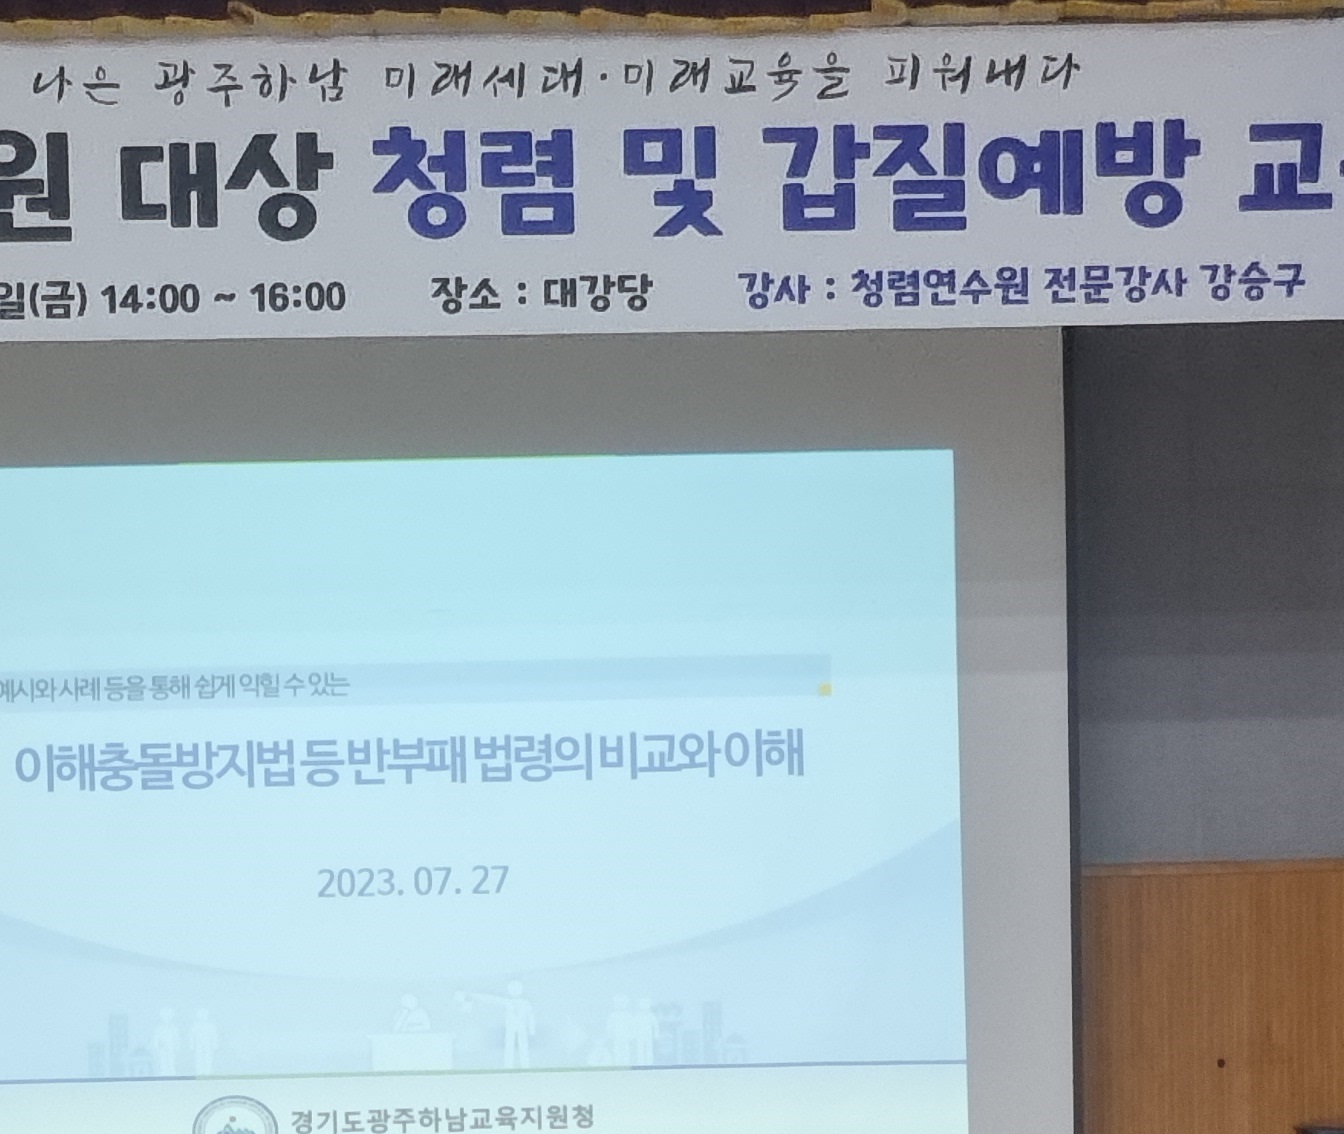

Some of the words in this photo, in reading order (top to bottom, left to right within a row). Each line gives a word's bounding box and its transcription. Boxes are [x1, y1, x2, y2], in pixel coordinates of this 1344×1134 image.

[32, 64, 120, 105] 나은
[155, 58, 348, 107] 광주하남
[885, 52, 1081, 93] 피워내다
[119, 131, 334, 241] 대상
[372, 125, 576, 240] 청렴
[622, 125, 723, 238] 및
[762, 118, 1201, 232] 갑질예방
[101, 282, 201, 314] 14:00
[250, 280, 346, 312] 16:00
[431, 276, 501, 314] 장소
[543, 273, 654, 312] 대강당
[737, 271, 811, 310] 강사
[852, 266, 1029, 310] 청렴연수원
[1043, 264, 1188, 305] 전문강사
[1199, 261, 1306, 303] 강승구
[59, 676, 101, 702] 사례
[104, 675, 147, 702] 등을
[149, 674, 191, 702] 통해
[194, 673, 235, 700] 쉽게
[239, 672, 280, 699] 익힐
[284, 672, 305, 697] 수
[308, 671, 351, 697] 있는
[14, 738, 295, 793] 이해충돌방지법
[300, 738, 345, 788] 등
[347, 735, 468, 786] 반부패
[473, 732, 594, 784] 법령의
[599, 730, 723, 781] 비교와
[724, 727, 805, 778] 이해
[317, 868, 404, 899] 2023.
[413, 866, 462, 897] 07.
[471, 864, 510, 895] 27
